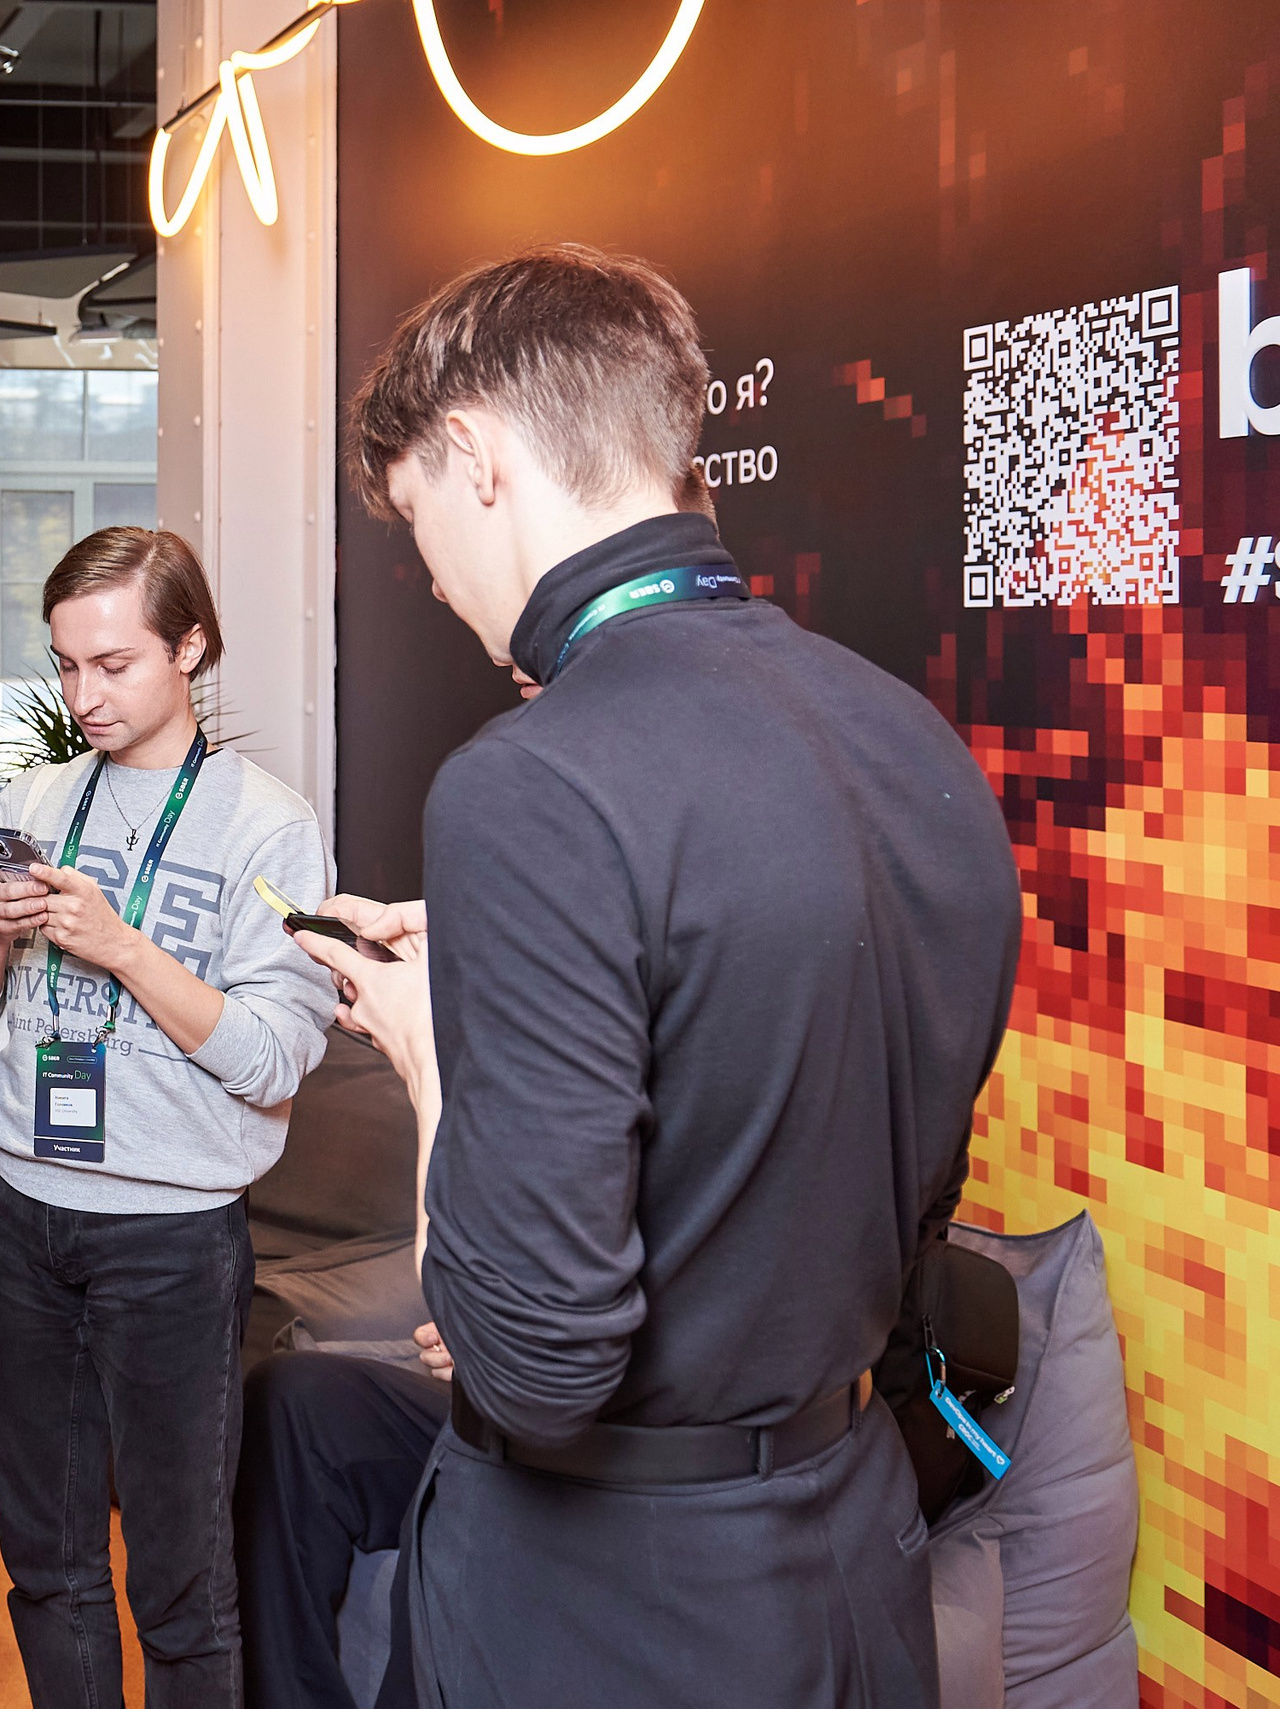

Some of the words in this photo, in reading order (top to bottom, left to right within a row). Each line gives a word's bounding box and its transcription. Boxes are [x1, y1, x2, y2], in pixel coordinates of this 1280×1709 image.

[703, 380, 727, 415] о
[735, 357, 774, 411] я?
[696, 574, 718, 589] Day
[629, 584, 661, 599] SBER
[178, 777, 190, 792] SBER
[163, 810, 176, 824] Day
[144, 859, 154, 875] SBER
[131, 895, 143, 911] Day
[48, 1072, 74, 1080] Community
[74, 1069, 92, 1081] Day
